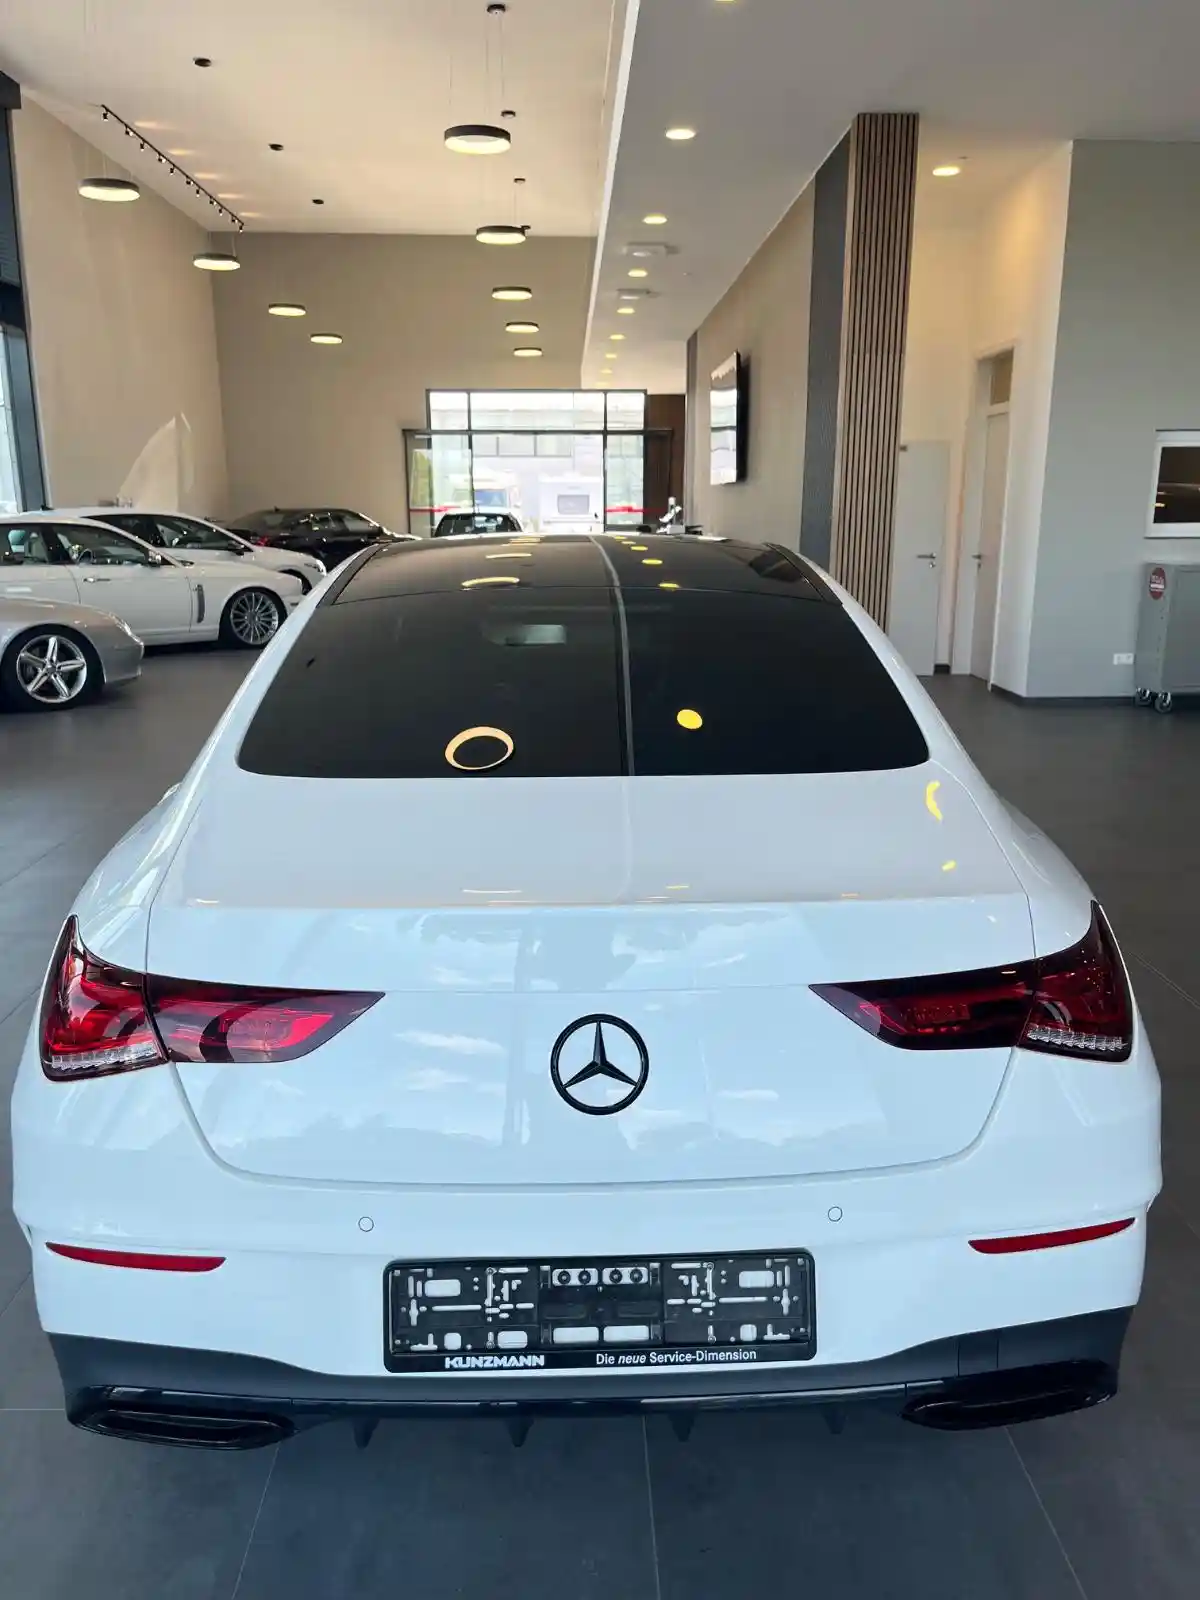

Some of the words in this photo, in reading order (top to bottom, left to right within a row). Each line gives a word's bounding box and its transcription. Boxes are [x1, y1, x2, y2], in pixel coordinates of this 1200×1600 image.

[445, 1355, 545, 1369] KUNZMANN
[595, 1351, 615, 1365] Die
[617, 1353, 646, 1365] neue
[649, 1349, 757, 1363] Service-Dimension
